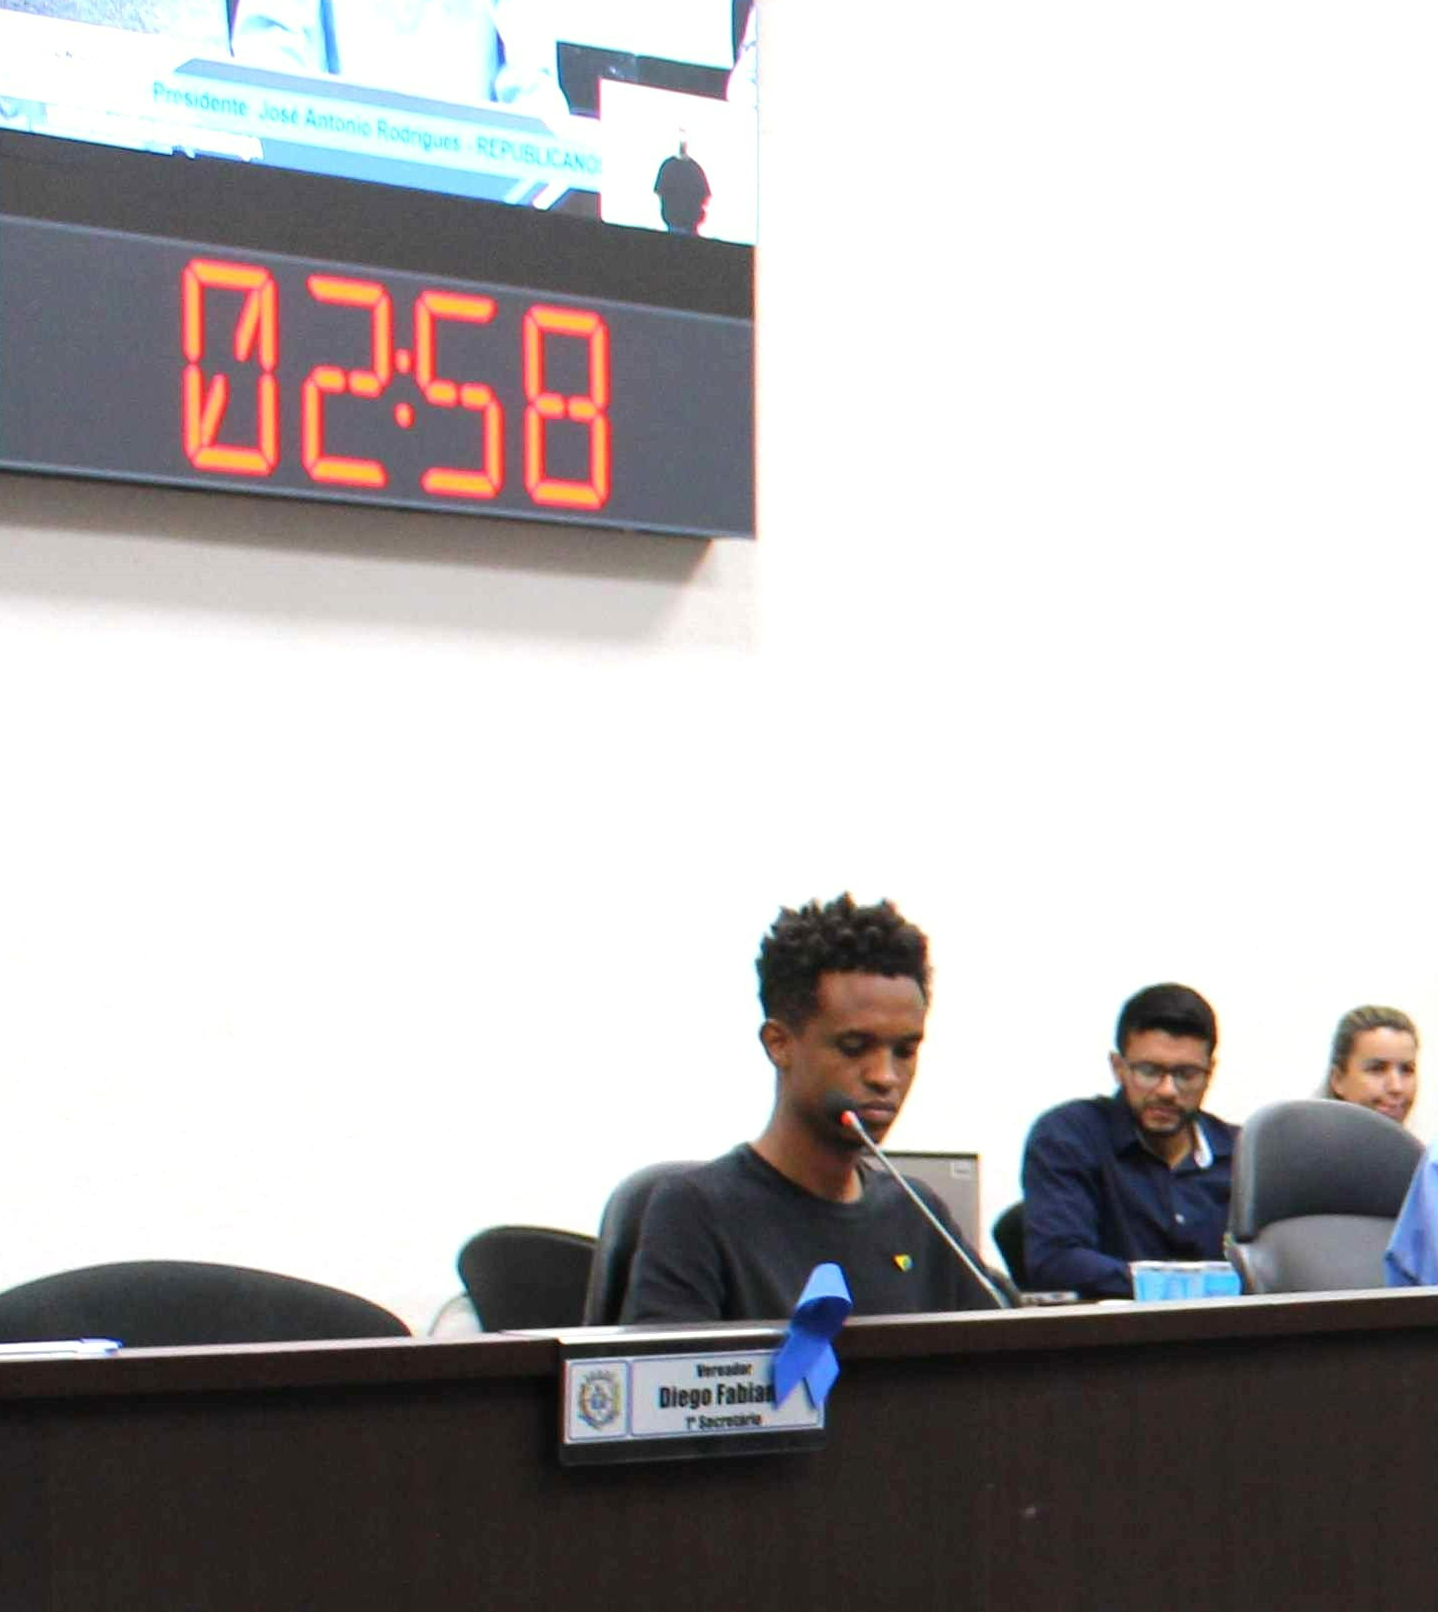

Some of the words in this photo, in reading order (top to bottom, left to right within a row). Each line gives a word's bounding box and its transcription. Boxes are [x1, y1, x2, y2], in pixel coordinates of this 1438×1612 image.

[153, 82, 247, 117] Presidente
[260, 102, 298, 124] José
[306, 107, 372, 138] Antonio
[377, 118, 461, 153] Rodrigues
[182, 258, 611, 512] 02:58
[696, 1361, 752, 1378] Vereador
[659, 1385, 712, 1409] Diego
[717, 1381, 775, 1405] Fabian
